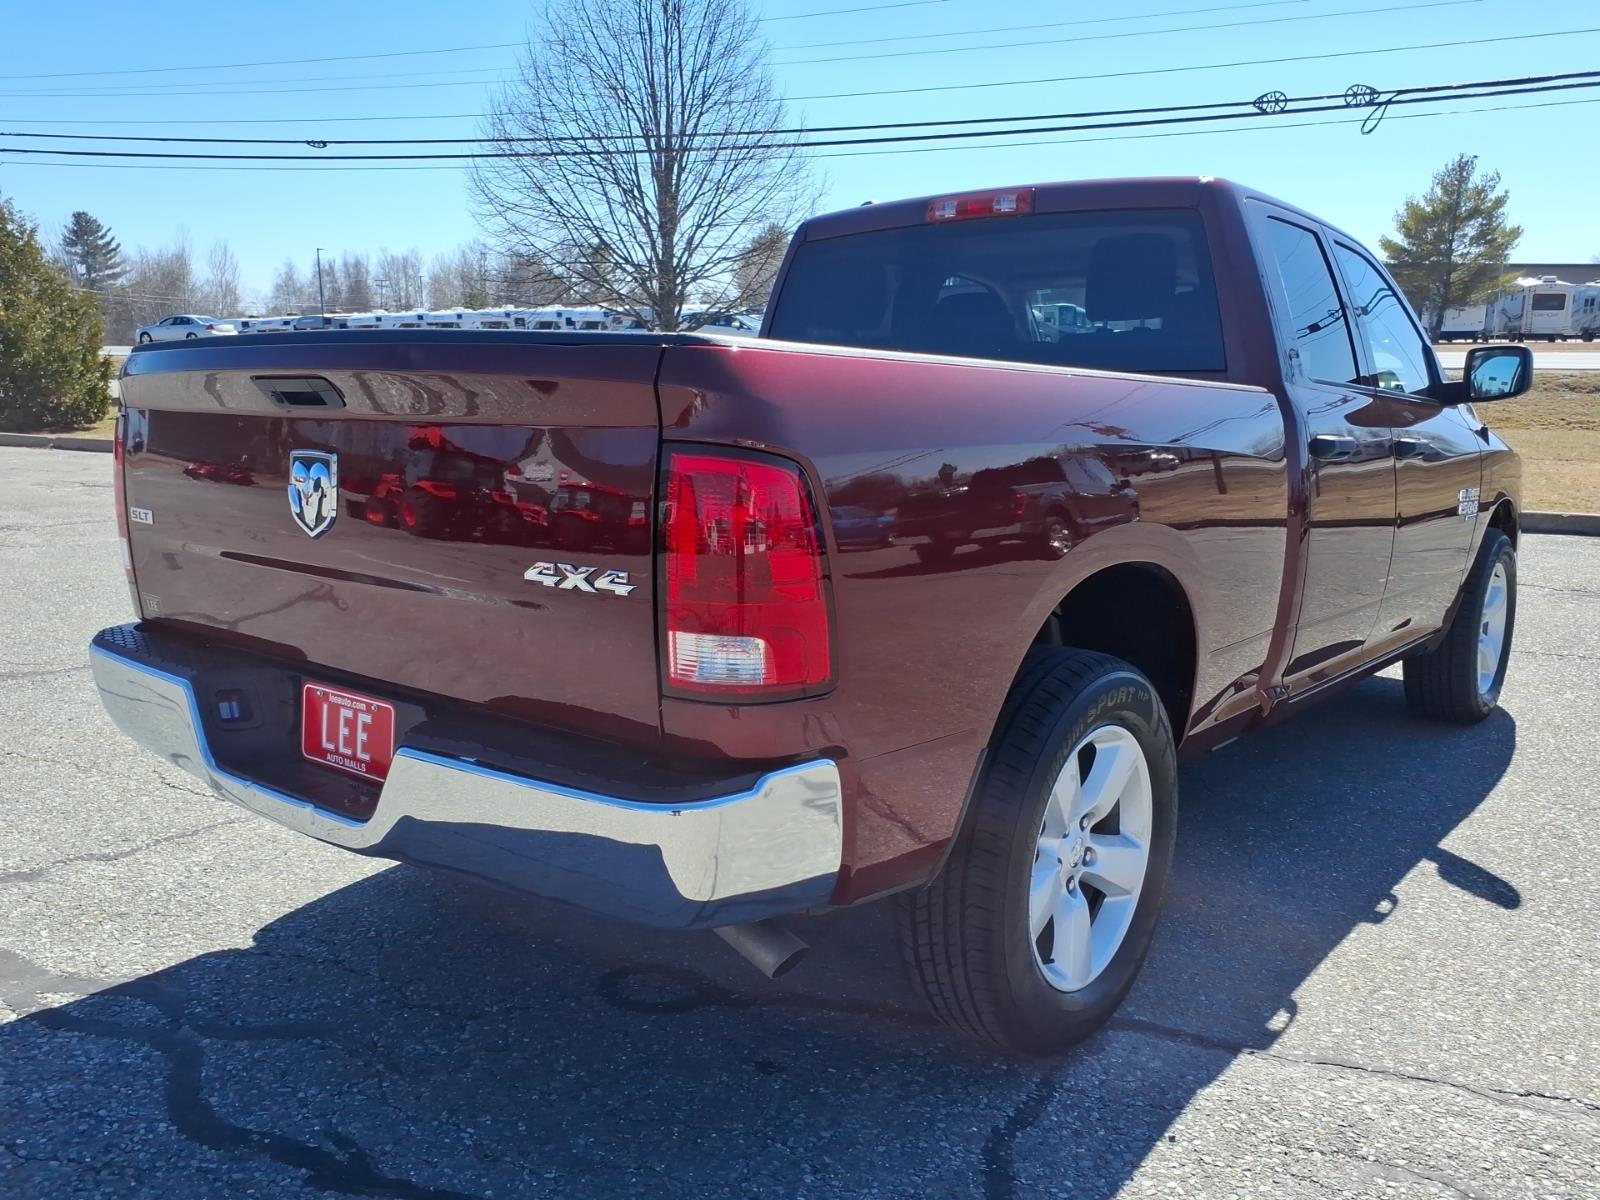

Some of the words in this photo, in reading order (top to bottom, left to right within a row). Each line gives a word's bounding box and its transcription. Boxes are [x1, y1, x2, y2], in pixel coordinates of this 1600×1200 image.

[131, 509, 150, 521] SLT
[328, 692, 367, 711] leeauto.com
[1088, 686, 1136, 723] SPORT
[322, 702, 372, 763] LEE
[326, 752, 344, 766] AUTO
[344, 758, 366, 772] MALLS
